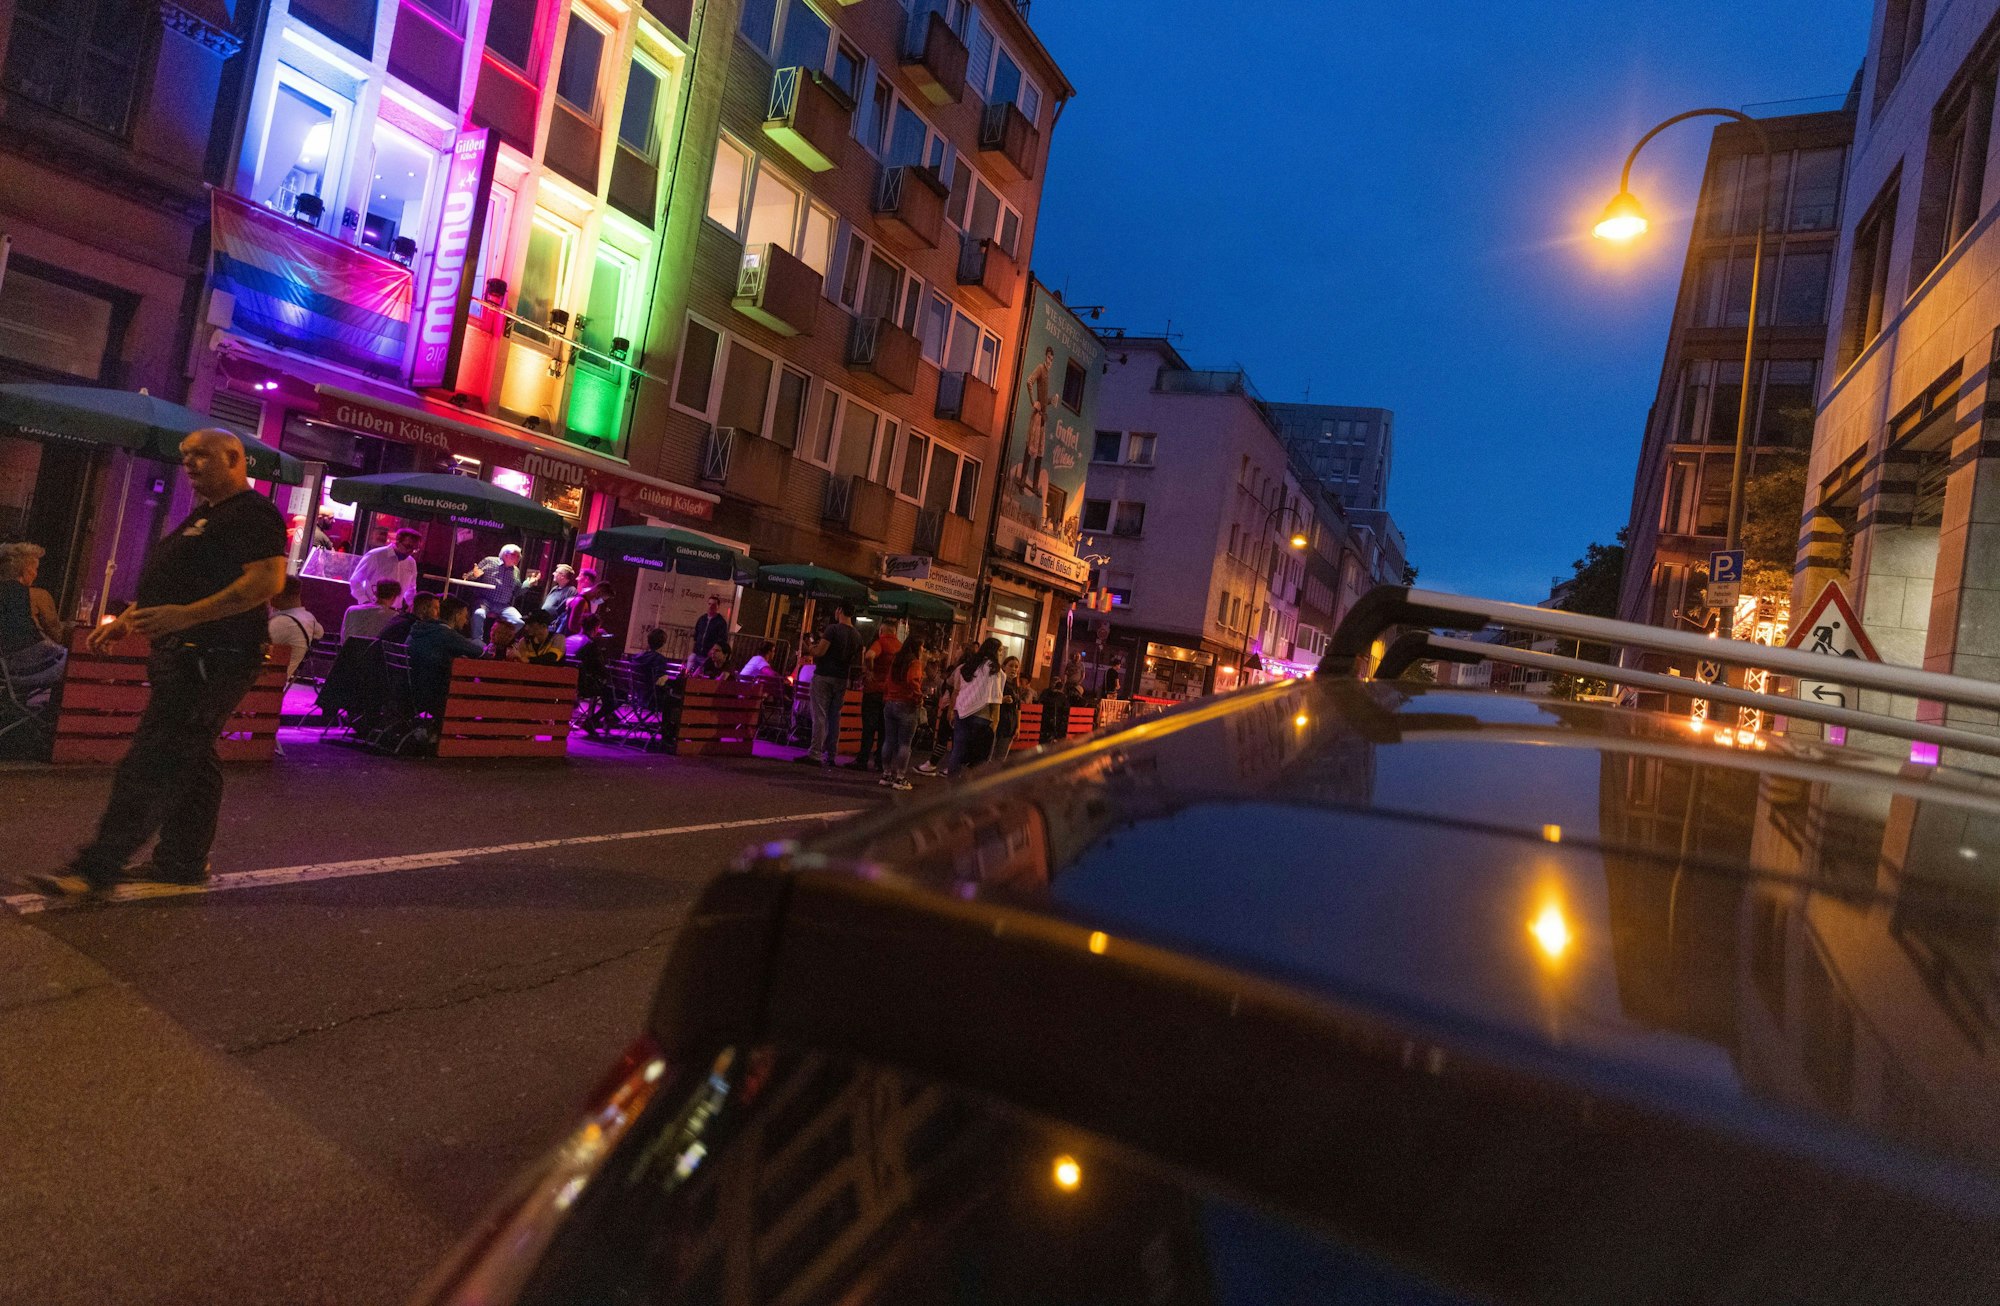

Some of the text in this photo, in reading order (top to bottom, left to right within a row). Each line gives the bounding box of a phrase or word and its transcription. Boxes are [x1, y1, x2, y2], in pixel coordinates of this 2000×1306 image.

[455, 139, 486, 154] Gilden
[336, 405, 450, 450] Gilden Kölsch
[403, 494, 468, 511] Gilden Kölsch
[640, 487, 704, 516] Gilden Kölsch
[676, 546, 721, 560] Gilden Kölsch
[1714, 555, 1733, 582] P
